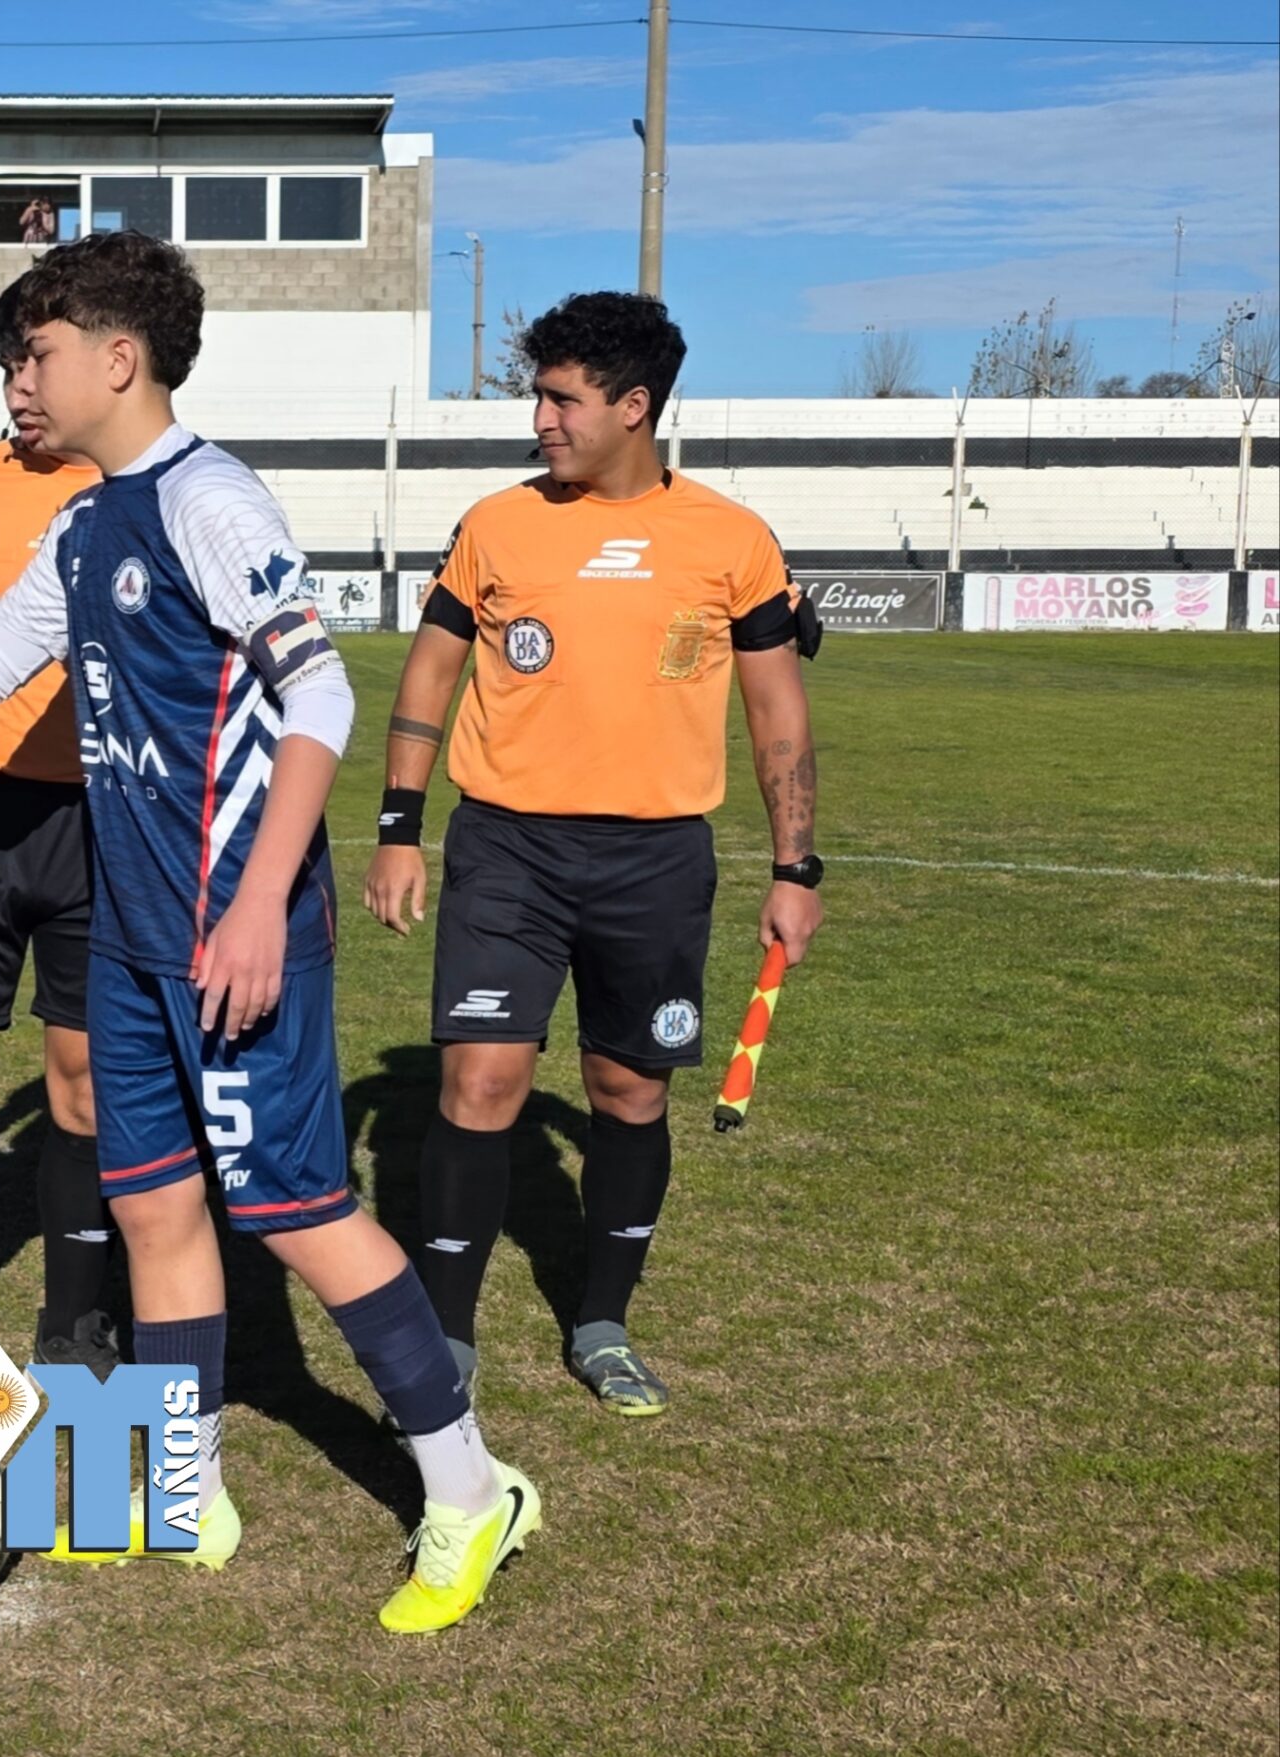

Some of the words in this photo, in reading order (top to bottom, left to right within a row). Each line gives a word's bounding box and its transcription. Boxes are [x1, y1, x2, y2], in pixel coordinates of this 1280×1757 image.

[818, 582, 906, 617] Linaje
[1016, 577, 1152, 598] CARLOS
[1014, 599, 1154, 619] MOYANO
[202, 1071, 253, 1147] 5
